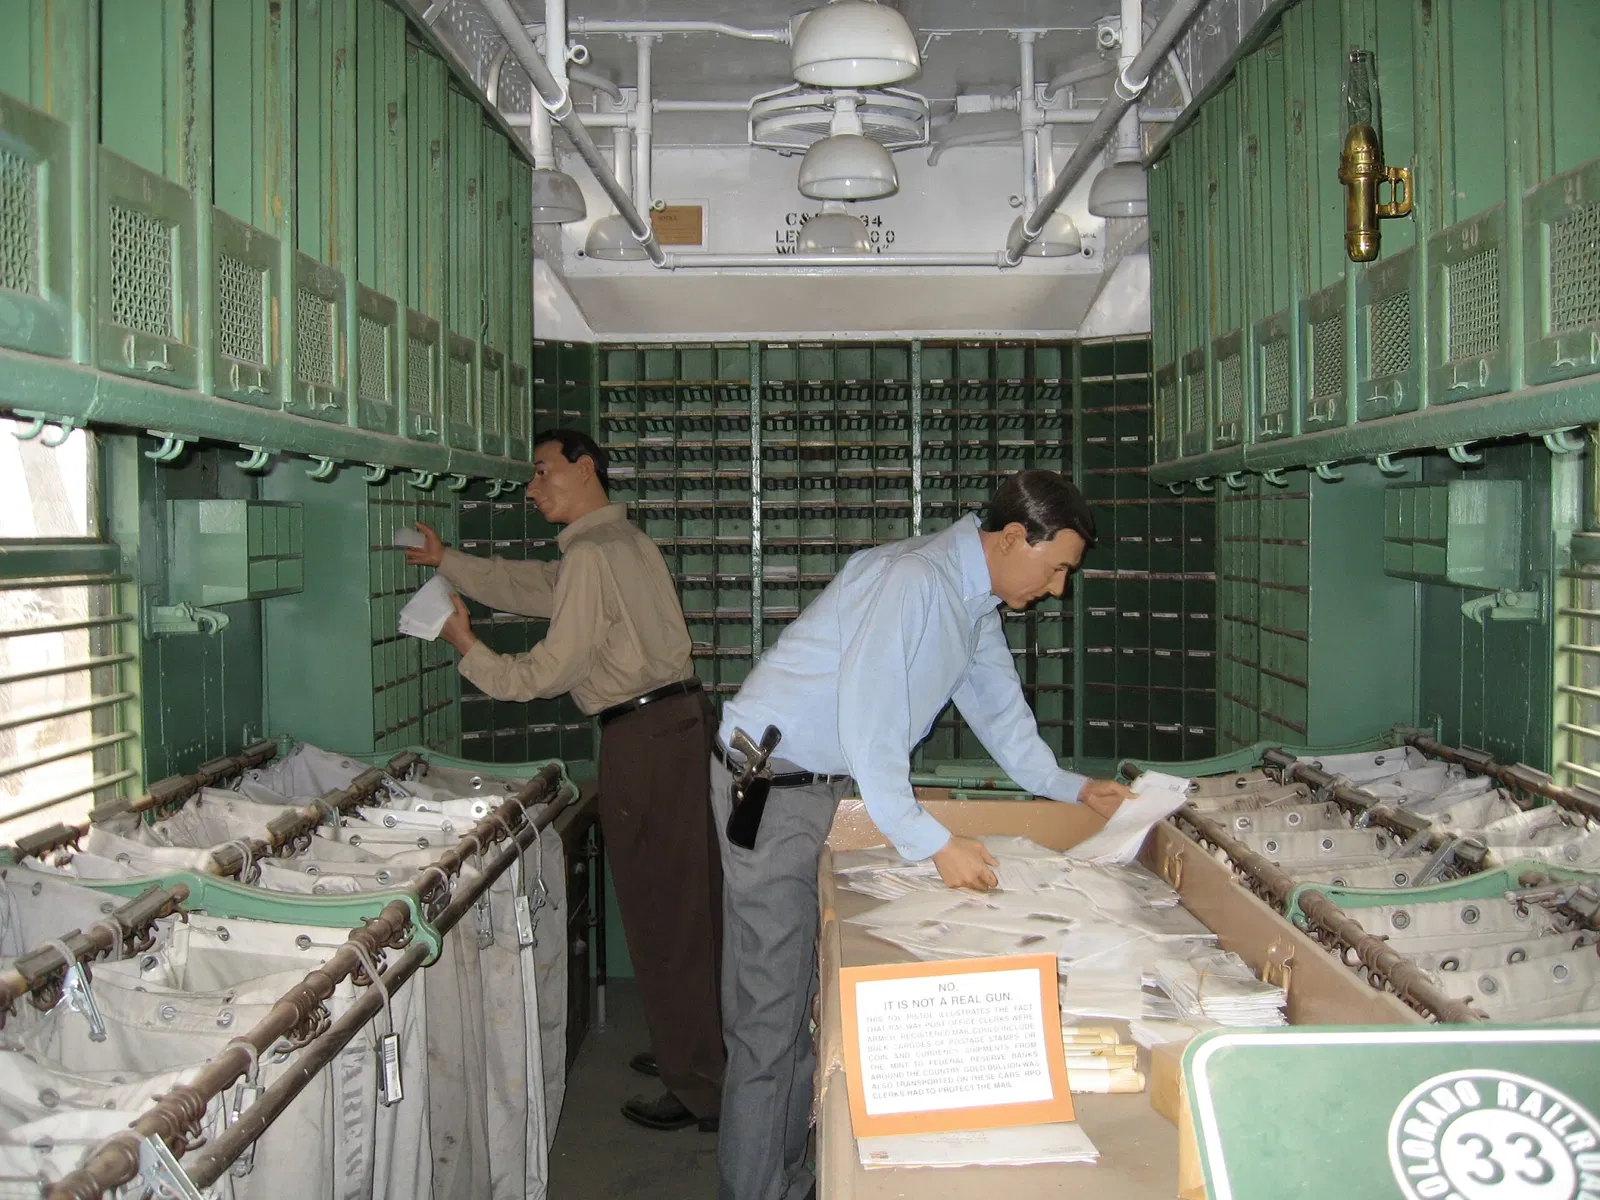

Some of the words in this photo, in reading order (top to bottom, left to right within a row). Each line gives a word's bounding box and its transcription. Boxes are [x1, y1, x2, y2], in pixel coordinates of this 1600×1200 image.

[939, 982, 958, 992] NO.
[884, 1001, 893, 1011] IT
[898, 1000, 908, 1009] IS
[912, 998, 935, 1008] NOT
[940, 997, 947, 1006] A
[951, 995, 981, 1005] REAL
[986, 992, 1013, 1002] GUN.
[939, 1008, 990, 1018] ILLUSTRATES
[979, 1015, 1009, 1024] CLERKS
[972, 1026, 1000, 1035] COULD
[1001, 1022, 1034, 1032] INCLUDE
[868, 1044, 888, 1052] BULK
[989, 1033, 1019, 1043] STAMPS
[868, 1054, 888, 1062] COIN
[894, 1051, 910, 1060] AND
[890, 1061, 909, 1069] MINT
[929, 1055, 964, 1066] FEDERAL
[970, 1053, 1007, 1062] RESERVE
[1012, 1050, 1039, 1059] BANKS
[871, 1071, 904, 1080] AROUND
[906, 1069, 920, 1077] THE
[964, 1064, 986, 1072] GOLD
[987, 1061, 1021, 1071] BULLION
[1023, 1059, 1039, 1068] WAS
[871, 1081, 893, 1089] ALSO
[896, 1076, 954, 1088] TRANSPORTED
[971, 1072, 995, 1080] THESE
[872, 1090, 904, 1100] CLERKS
[907, 1088, 924, 1096] HAD
[938, 1083, 974, 1093] PROTECT
[977, 1082, 991, 1091] THE
[1457, 1132, 1555, 1186] 33
